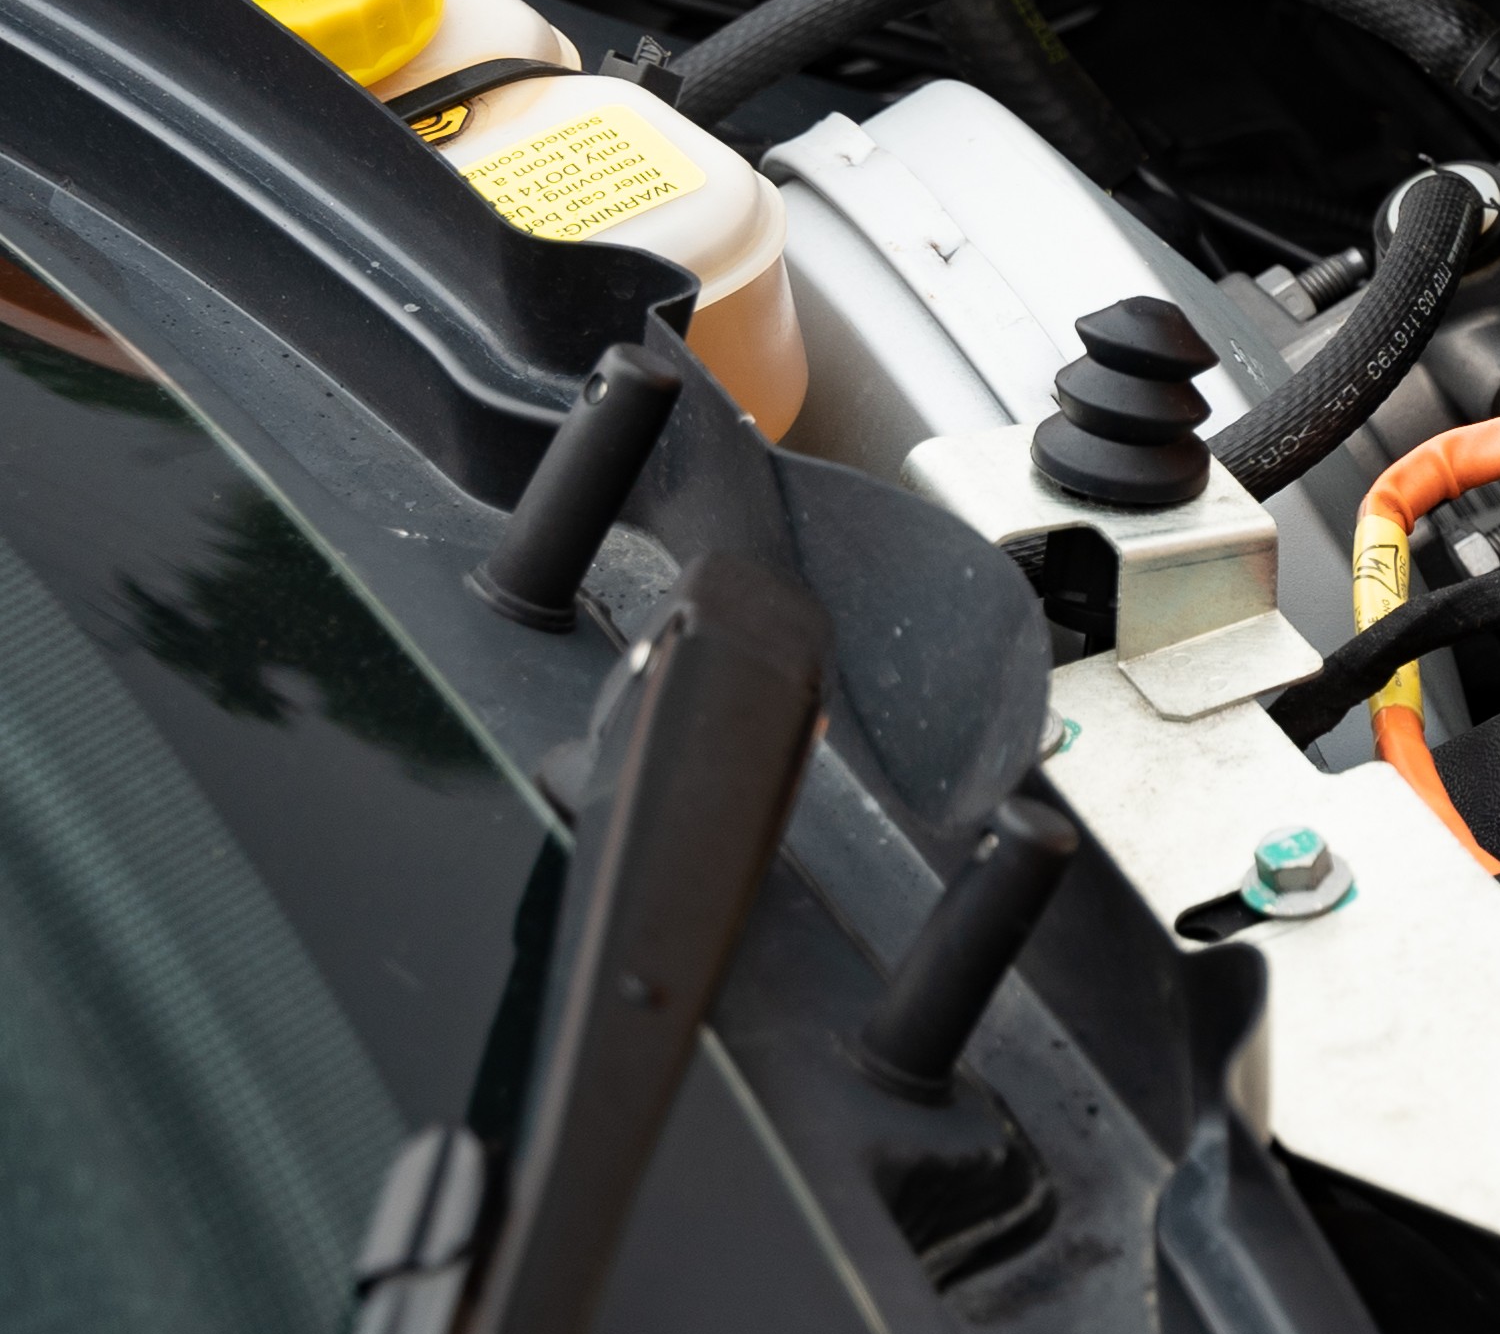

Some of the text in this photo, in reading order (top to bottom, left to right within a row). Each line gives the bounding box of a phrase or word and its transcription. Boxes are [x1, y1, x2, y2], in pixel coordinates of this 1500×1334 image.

[530, 117, 602, 151] sealed
[492, 128, 618, 187] fluid from a
[587, 141, 629, 164] only
[518, 165, 580, 196] DOT4
[538, 154, 646, 204] removing.
[615, 167, 662, 194] filler
[556, 181, 677, 237] WARNING:
[566, 191, 606, 212] cap
